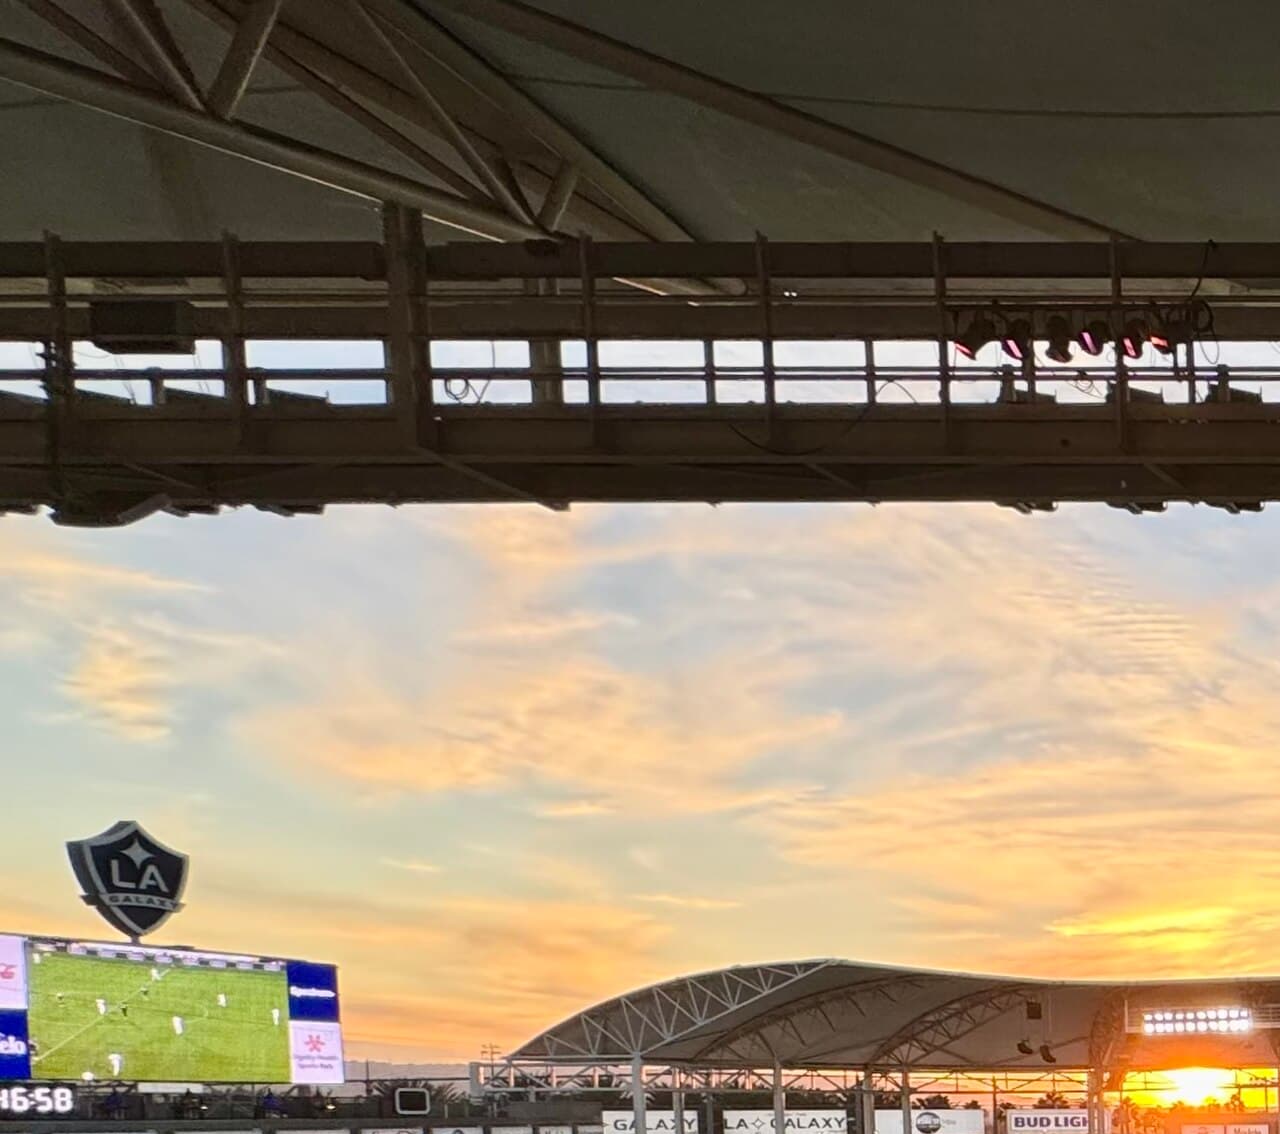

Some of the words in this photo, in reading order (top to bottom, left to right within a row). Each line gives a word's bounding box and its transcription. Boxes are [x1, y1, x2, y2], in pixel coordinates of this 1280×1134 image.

[111, 859, 169, 892] LA
[109, 895, 178, 910] GALAXY
[0, 1033, 26, 1055] elo
[724, 1118, 749, 1130] LA
[1014, 1116, 1051, 1128] BUD
[1054, 1116, 1088, 1127] LIG
